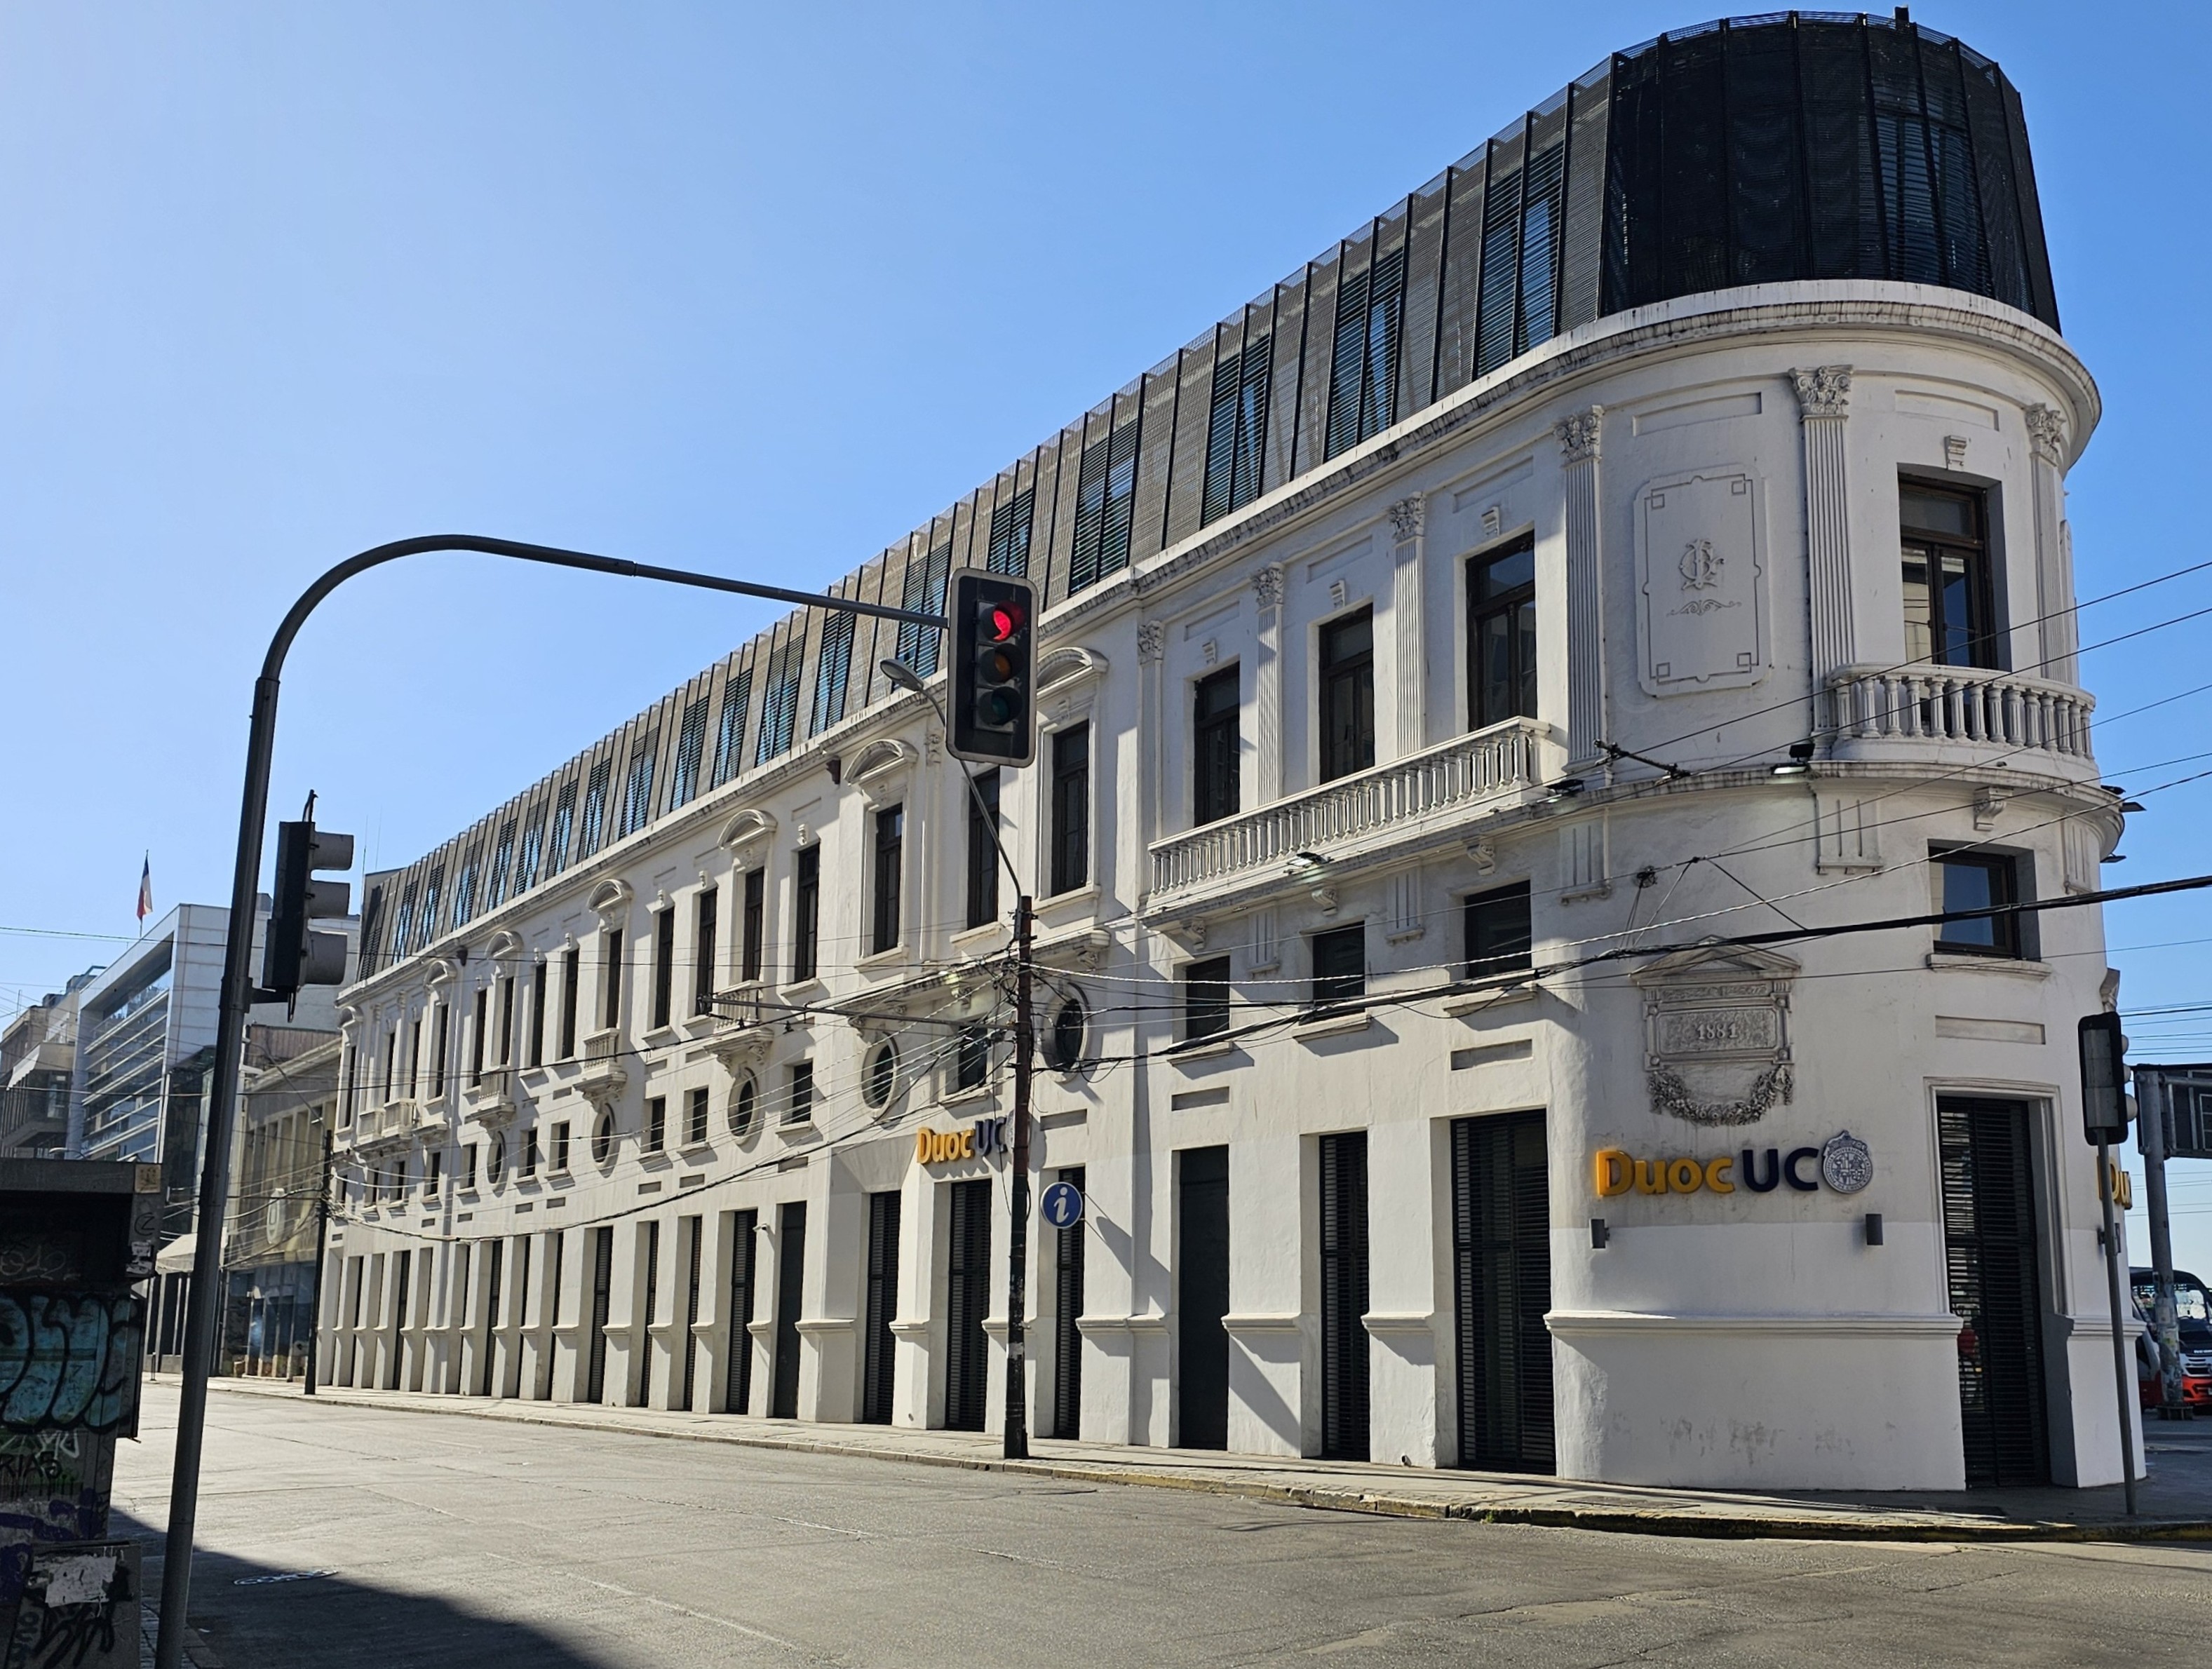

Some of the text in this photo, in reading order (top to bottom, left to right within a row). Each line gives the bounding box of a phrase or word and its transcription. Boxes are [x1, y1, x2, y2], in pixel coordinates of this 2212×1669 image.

[1696, 1022, 1739, 1040] 1881
[916, 1126, 975, 1165] Duoc
[1596, 1147, 1819, 1196] Duoc UC
